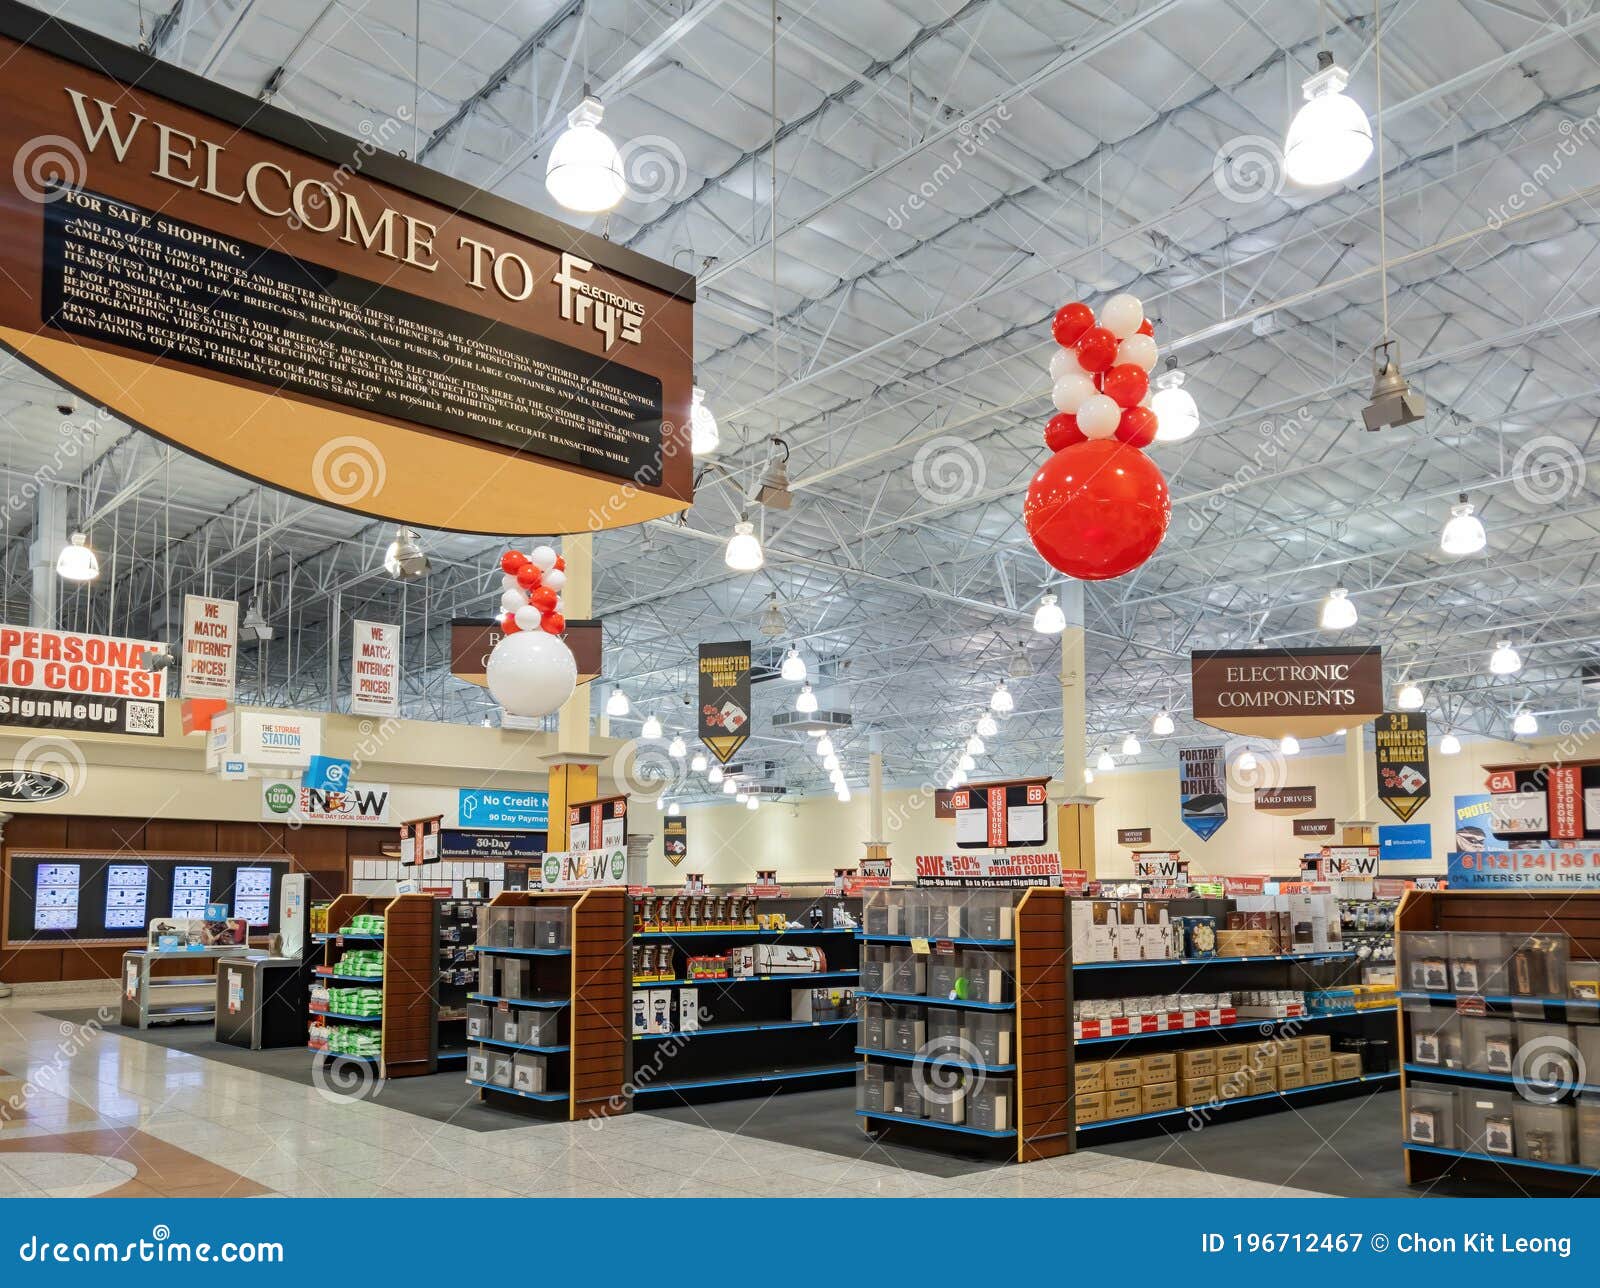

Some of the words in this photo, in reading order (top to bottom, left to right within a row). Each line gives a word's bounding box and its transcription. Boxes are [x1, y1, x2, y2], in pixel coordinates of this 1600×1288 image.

[64, 87, 438, 273] WELCOME
[458, 235, 533, 302] TO
[66, 190, 102, 213] FOR
[107, 201, 151, 228] SAFE
[157, 221, 247, 260] SHOPPING.
[64, 250, 103, 269] ITEMS
[108, 263, 120, 274] IN
[126, 268, 156, 285] YOUR
[160, 279, 185, 294] CAR.
[581, 282, 646, 317] ELECTRONICS
[64, 224, 124, 250] CAMERAS
[128, 243, 159, 260] WITH
[164, 255, 199, 273] VIDEO
[204, 267, 229, 282] TAPE
[233, 276, 296, 303] RECORDERS,
[300, 297, 335, 314] WHICH
[339, 308, 379, 328] PROVIDE
[383, 321, 429, 343] EVIDENCE
[432, 336, 449, 348] FOR
[455, 343, 471, 355] THE
[475, 349, 531, 373] PROSECUTION
[534, 368, 543, 377] OF
[546, 372, 584, 391] CRIMINAL
[586, 385, 629, 406] OFFENDERS.
[65, 213, 100, 233] ...AND
[105, 226, 120, 239] TO
[124, 232, 161, 252] OFFER
[166, 245, 205, 265] LOWER
[210, 259, 247, 278] PRICES
[251, 272, 273, 286] AND
[277, 280, 314, 299] BETTER
[318, 293, 361, 314] SERVICE,
[365, 307, 394, 324] THESE
[398, 317, 443, 338] PREMISES
[446, 332, 463, 344] ARE
[467, 339, 528, 364] CONTINUOUSLY
[532, 359, 578, 380] MONITORED
[581, 376, 589, 384] BY
[592, 380, 621, 395] REMOTE
[623, 390, 654, 407] CONTROL
[62, 310, 145, 341] MAINTAINING
[150, 334, 173, 349] OUR
[179, 342, 206, 358] FAST,
[211, 350, 265, 373] FRIENDLY,
[269, 366, 328, 390] COURTEOUS
[331, 383, 374, 402] SERVICE.
[205, 603, 219, 618] WE
[194, 620, 228, 639] MATCH
[371, 626, 384, 641] WE
[0, 629, 158, 669] PERSONA
[187, 639, 233, 658] INTERNET
[191, 659, 227, 676] PRICES!
[356, 660, 394, 678] INTERNET
[700, 655, 750, 673] CONNECTED
[44, 661, 162, 698] CODES!
[712, 671, 738, 688] HOME
[1227, 664, 1349, 683] ELECTRONIC
[360, 678, 391, 695] PRICES!
[1218, 689, 1355, 708] COMPONENTS
[262, 724, 273, 732] THE
[274, 725, 301, 734] STORAGE
[1390, 713, 1409, 731] 3-D
[262, 732, 301, 746] STATION
[1376, 729, 1426, 747] PRINTERS
[1389, 746, 1425, 763] MAKER
[31, 785, 53, 797] 27
[1491, 776, 1512, 790] 6A
[267, 792, 293, 804] 1000
[483, 795, 499, 805] No
[503, 796, 539, 807] Credit
[955, 795, 967, 806] 8A
[1029, 789, 1041, 800] 6B
[1257, 796, 1282, 804] HARD
[1283, 795, 1313, 803] DRIVES
[501, 814, 516, 823] Day
[442, 848, 470, 856] Internet
[476, 838, 511, 850] 30-Day
[915, 855, 945, 877] SAVE
[952, 856, 980, 871] 50%
[1010, 853, 1060, 864] PERSONAL
[988, 865, 1022, 876] PROMO
[1024, 864, 1060, 875] CODES!
[1452, 874, 1468, 883] 0%
[1473, 873, 1530, 882] INTEREST
[1535, 873, 1553, 881] ON
[1558, 873, 1582, 881] THE
[919, 878, 944, 886] Sign-Up
[945, 878, 961, 886] Now!
